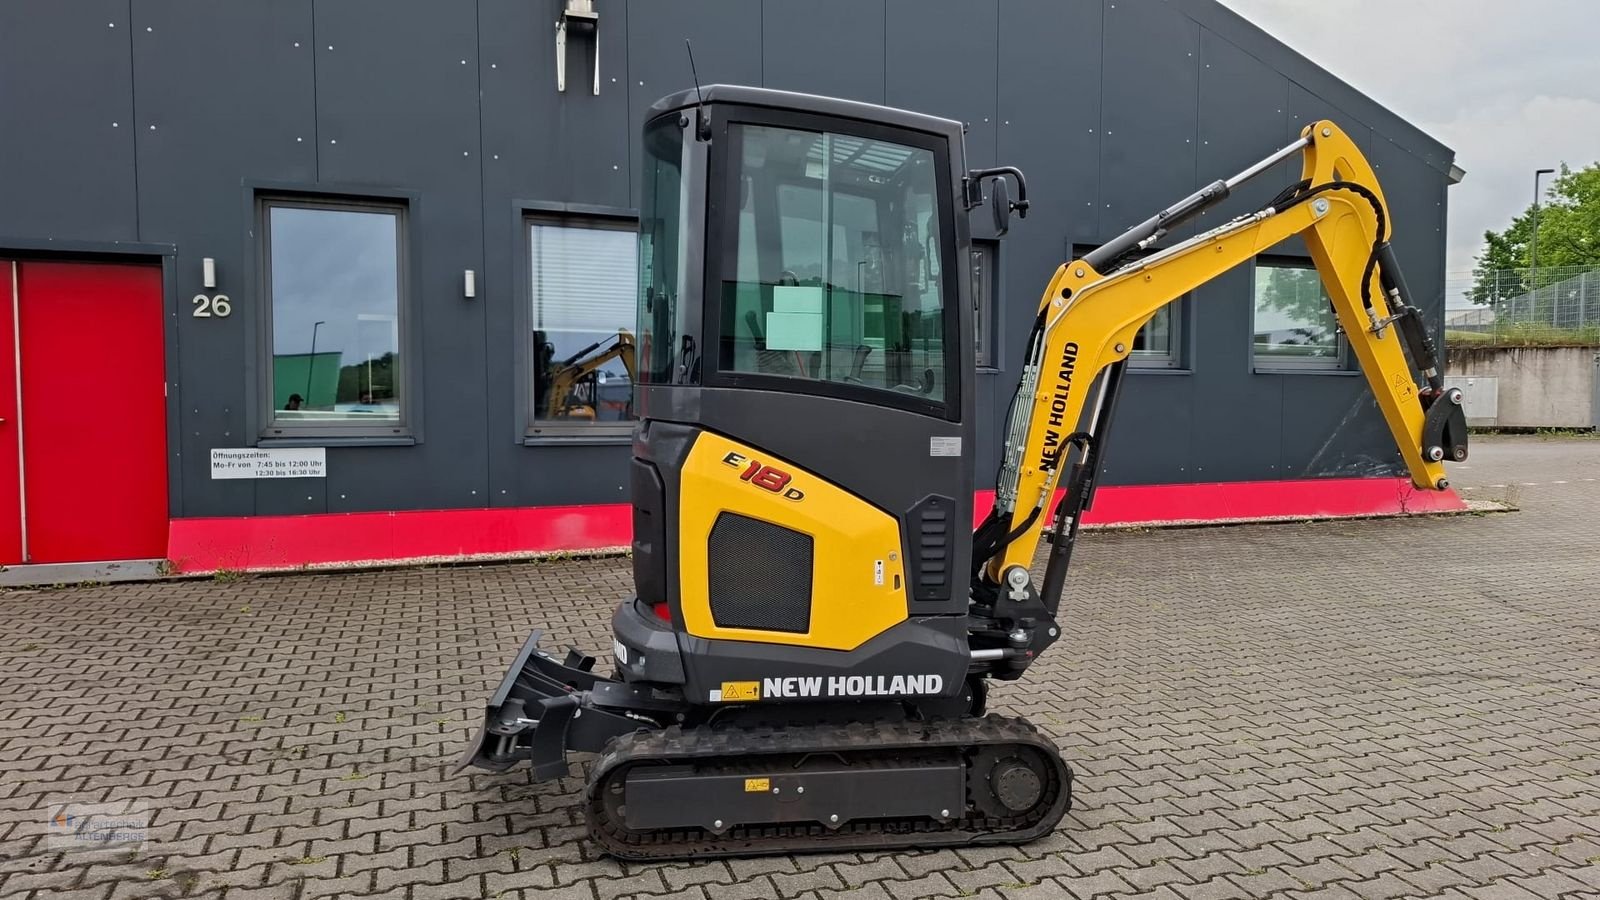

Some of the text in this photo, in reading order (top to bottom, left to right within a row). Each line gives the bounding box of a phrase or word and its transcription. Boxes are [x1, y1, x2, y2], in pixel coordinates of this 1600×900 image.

[193, 295, 231, 318] 26
[1039, 342, 1079, 472] NEW HOLLAND
[212, 451, 271, 460] Öffnungszeiten:
[763, 674, 943, 698] NEW HOLLAND
